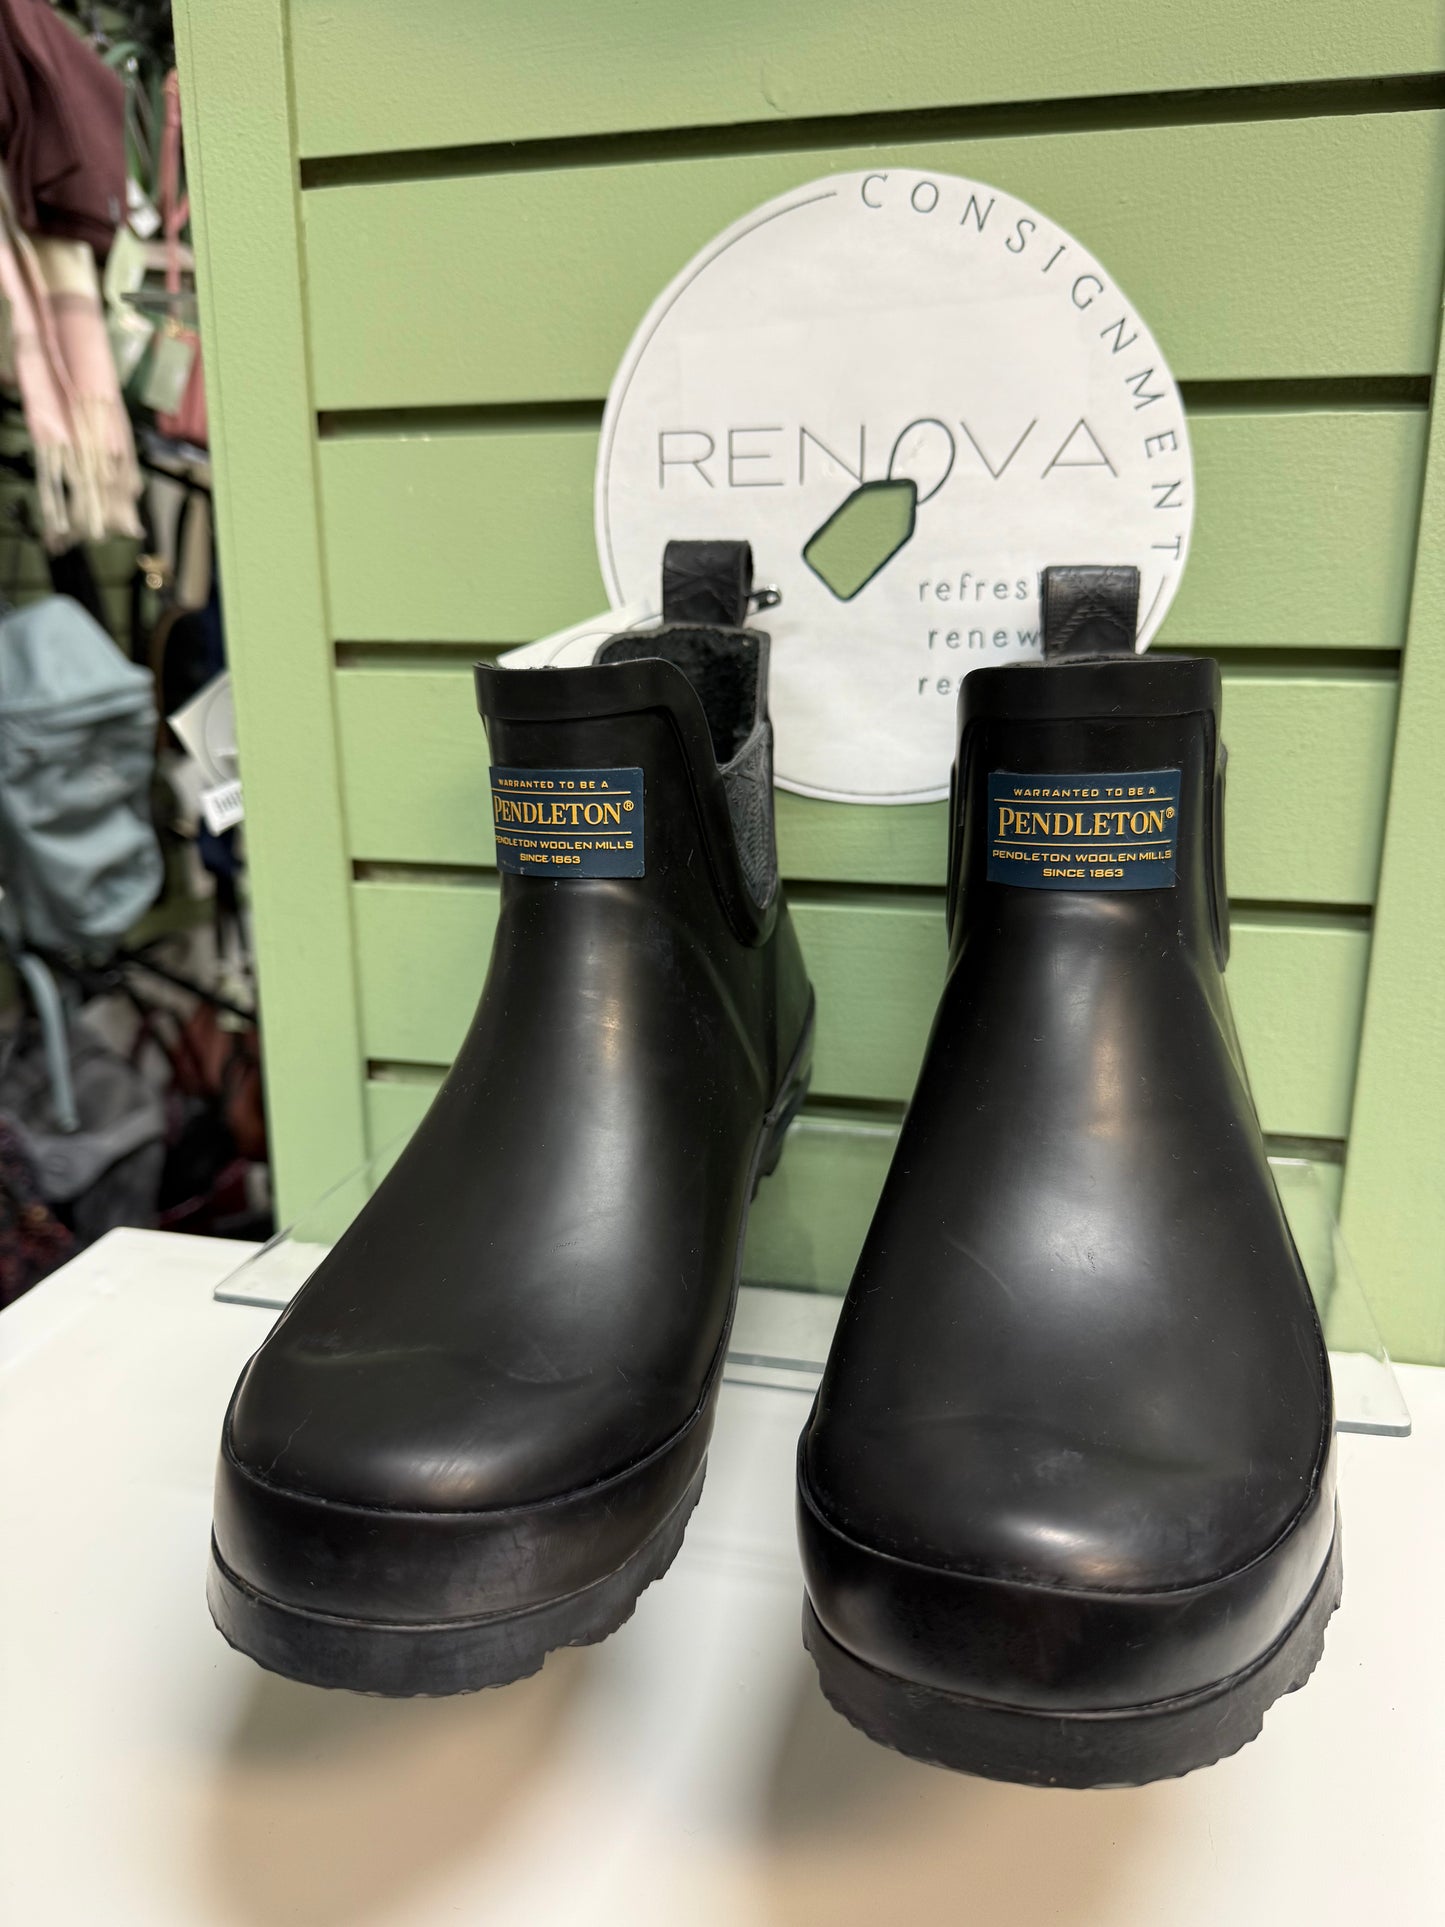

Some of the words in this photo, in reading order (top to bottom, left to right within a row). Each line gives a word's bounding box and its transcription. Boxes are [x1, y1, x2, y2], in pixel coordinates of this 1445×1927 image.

[861, 172, 1183, 561] CONSIGNMENT
[658, 417, 1119, 505] RENOVA
[498, 778, 554, 789] WARRANTED
[559, 781, 575, 789] TO
[580, 781, 595, 789] BE
[601, 781, 609, 789] A
[1013, 788, 1099, 798] WARRANTED
[1106, 788, 1123, 797] TO
[1128, 787, 1144, 796] BE
[1148, 786, 1156, 795] A
[540, 841, 592, 850] WOOLEN
[595, 840, 634, 850] MILLS
[519, 852, 549, 863] SINCE
[552, 855, 581, 864] 1863
[992, 849, 1071, 862] PENDLETON
[1075, 852, 1136, 863] WOOLEN
[1138, 849, 1172, 861] MILLS
[1042, 868, 1085, 878] SINCE
[1089, 868, 1124, 878] 1863
